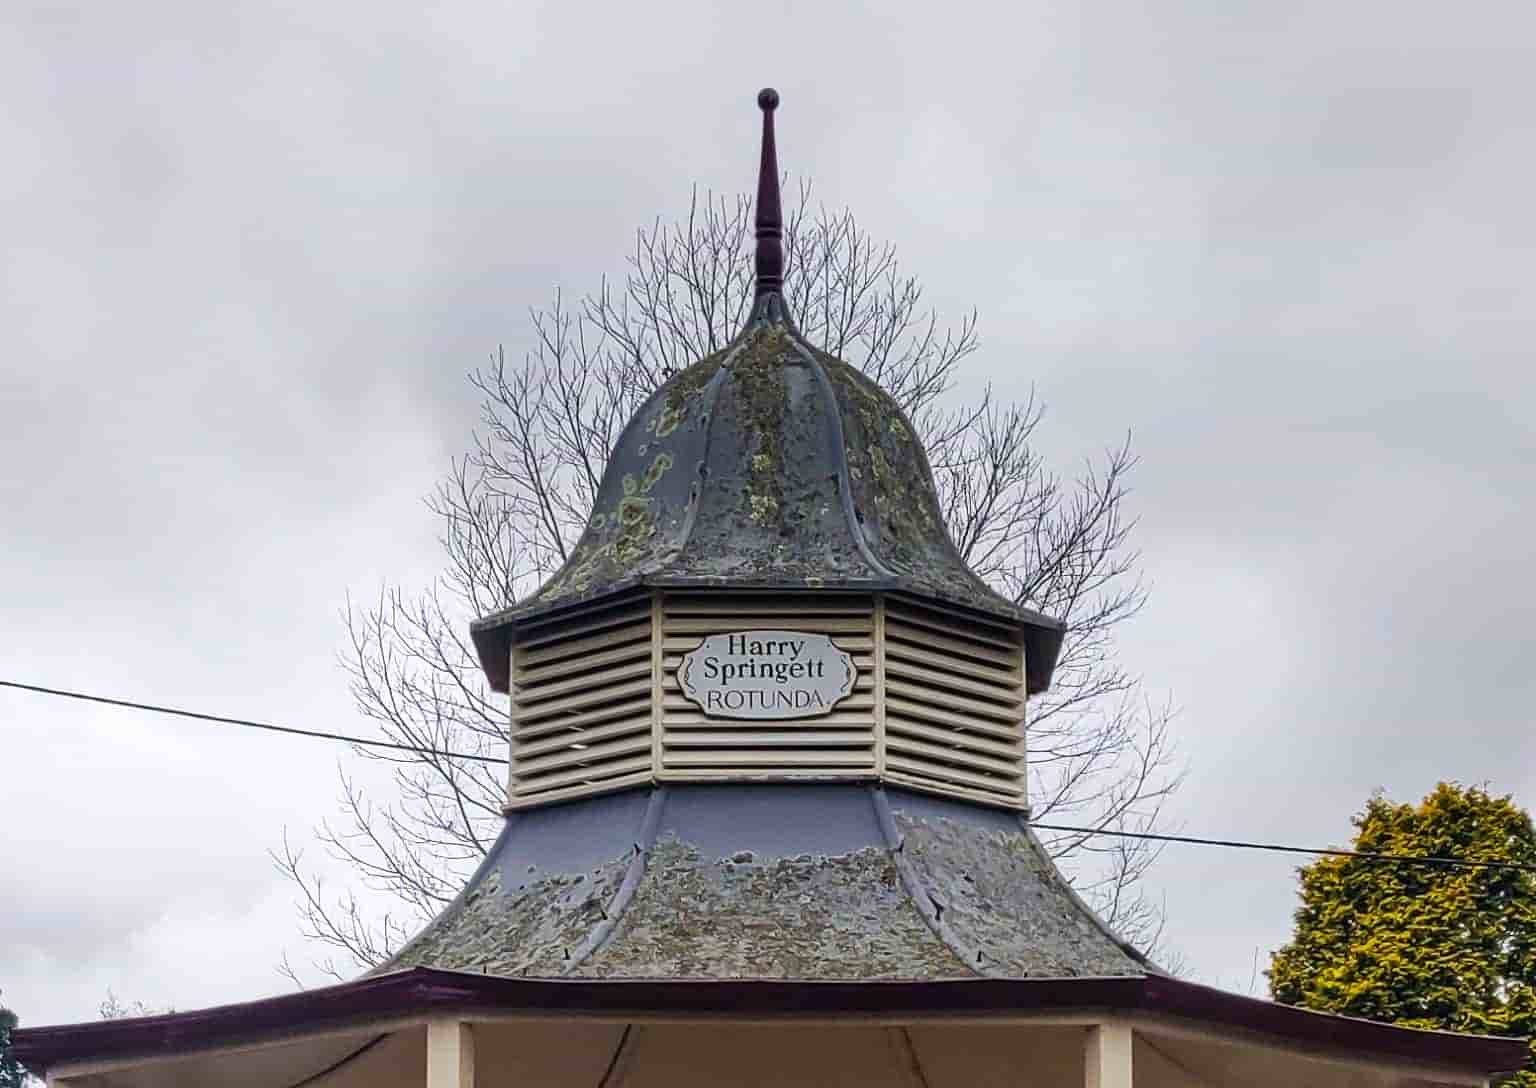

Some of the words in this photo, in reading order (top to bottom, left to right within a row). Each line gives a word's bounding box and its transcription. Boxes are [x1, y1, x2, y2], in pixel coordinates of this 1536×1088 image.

[728, 635, 806, 661] Harry
[704, 657, 824, 685] Springett
[708, 690, 823, 710] ROTUNDA
